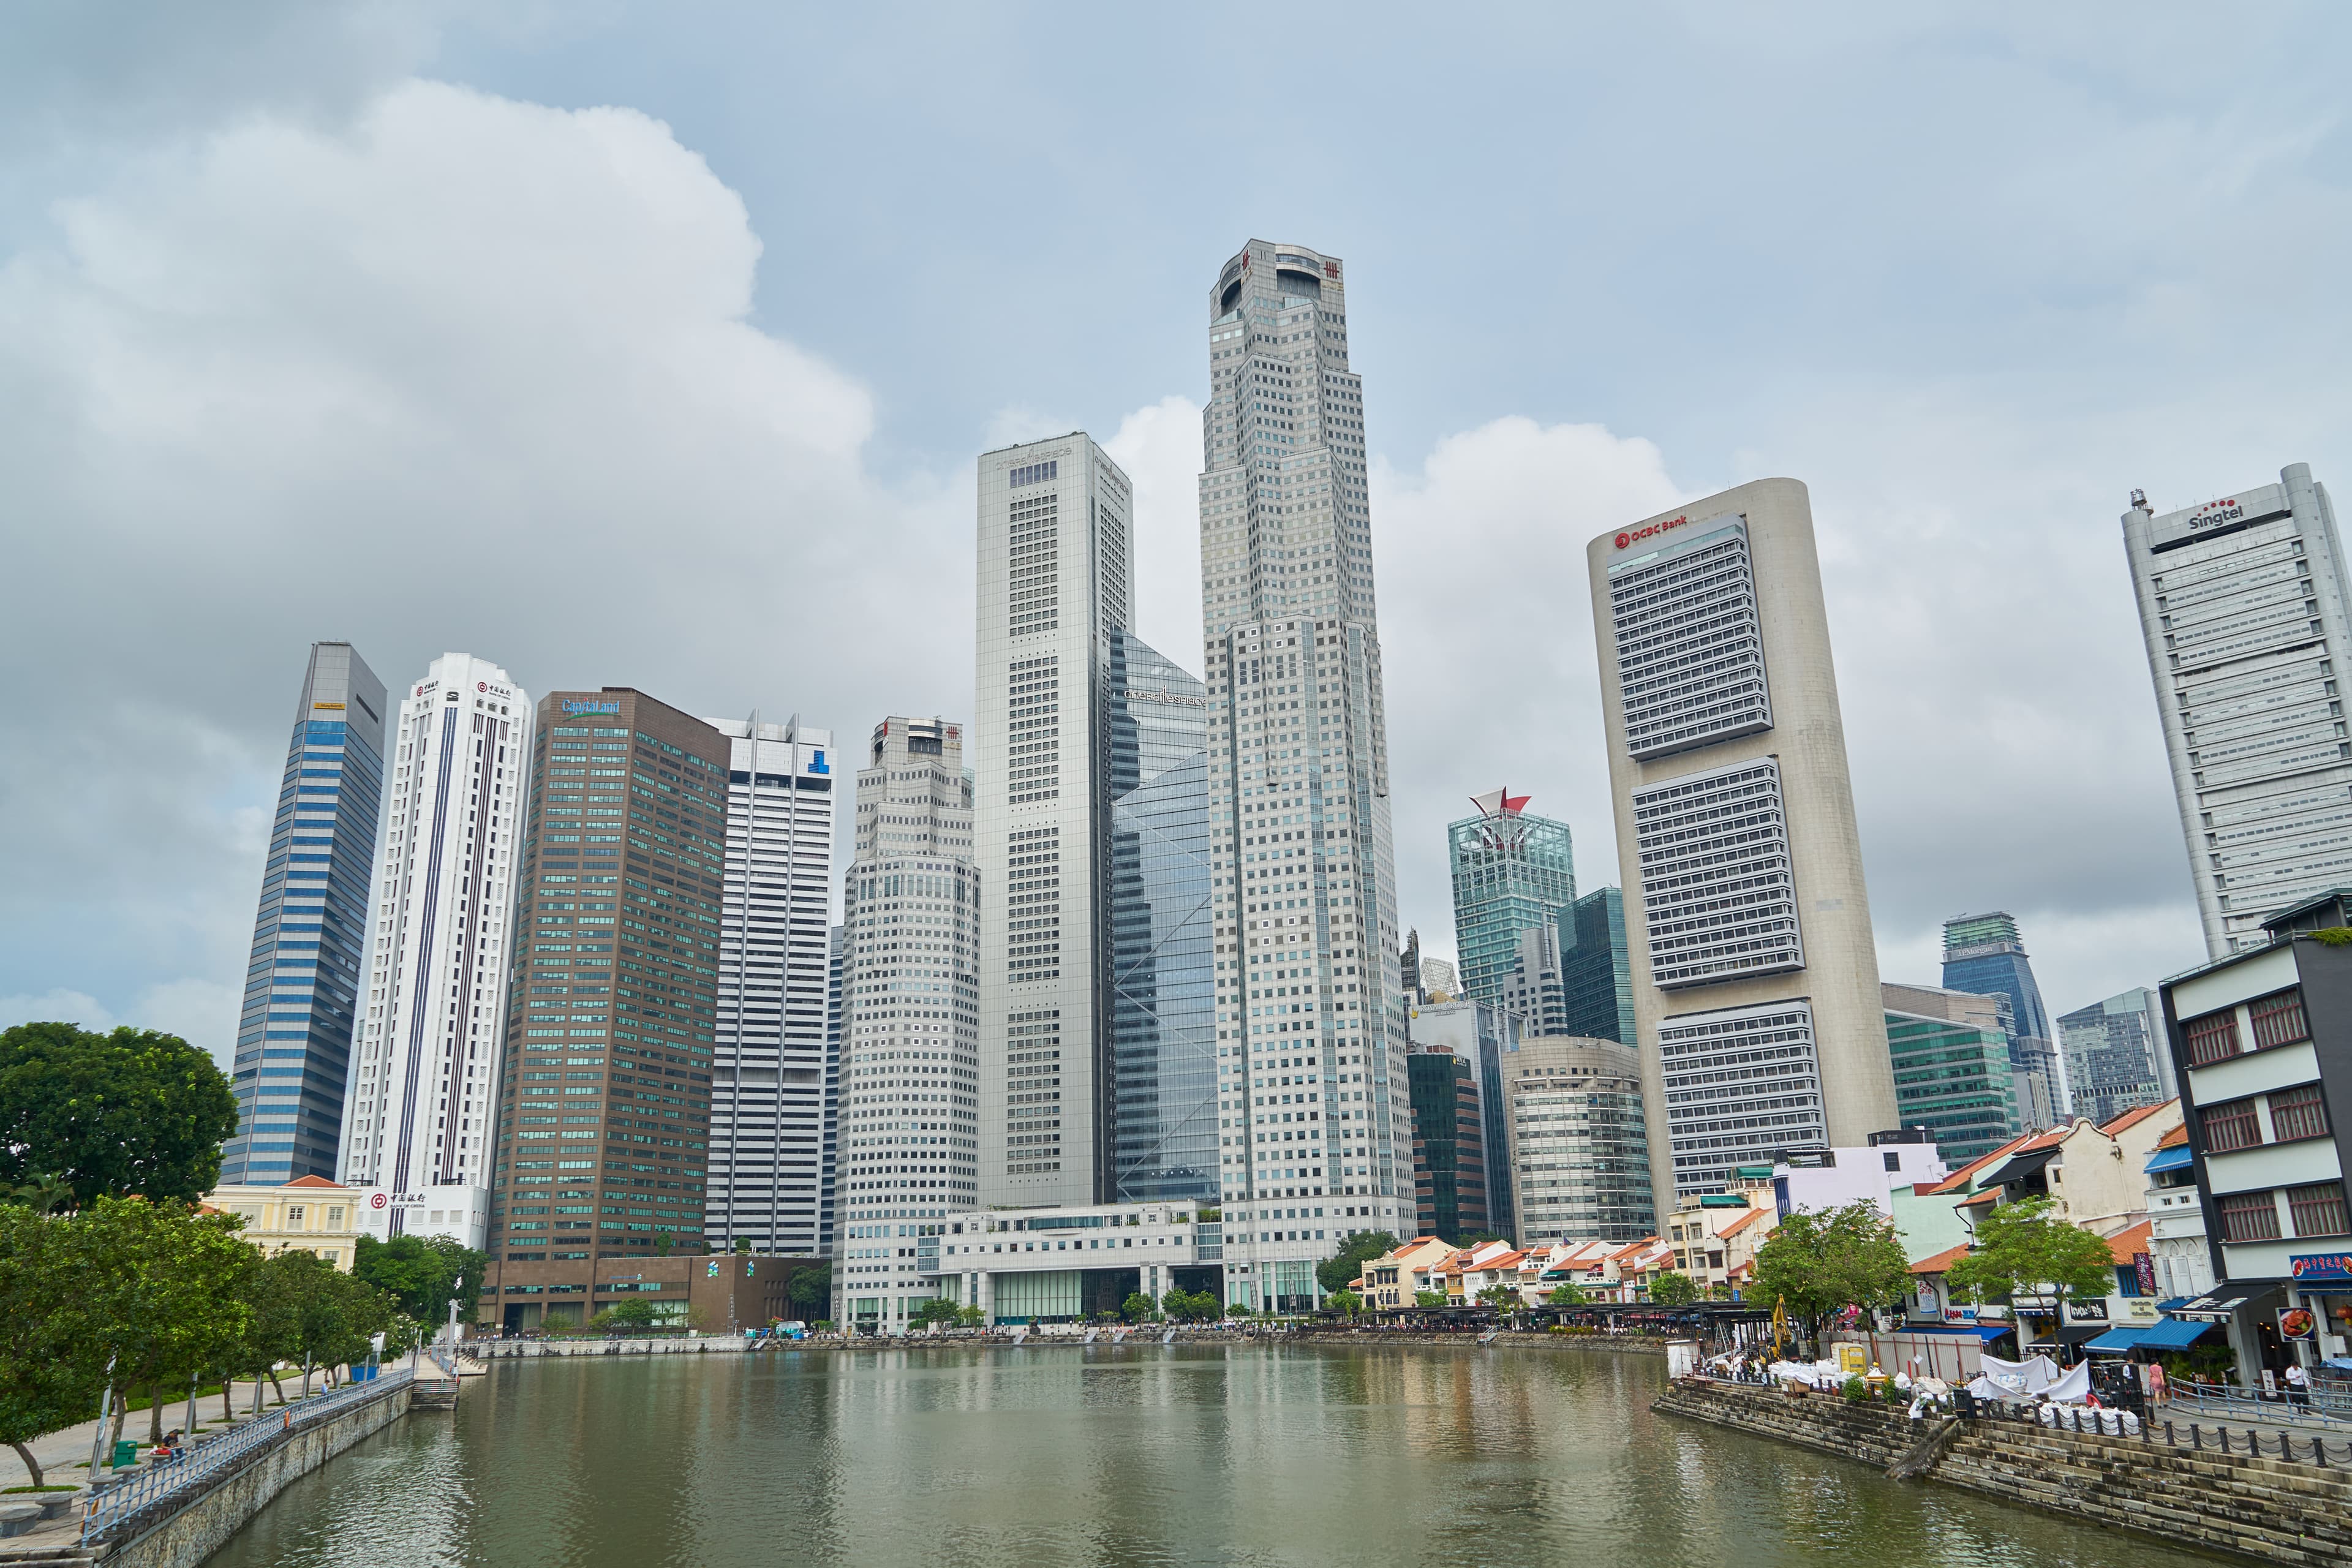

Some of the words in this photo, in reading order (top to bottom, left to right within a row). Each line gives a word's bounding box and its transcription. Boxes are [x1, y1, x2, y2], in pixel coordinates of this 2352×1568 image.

[1631, 524, 1660, 541] OCBC
[1662, 515, 1687, 530] Bank
[2189, 505, 2244, 530] Singtel
[562, 697, 620, 715] CapitaLand
[1420, 1004, 1441, 1012] ROYAL
[1445, 1001, 1470, 1010] GROUP
